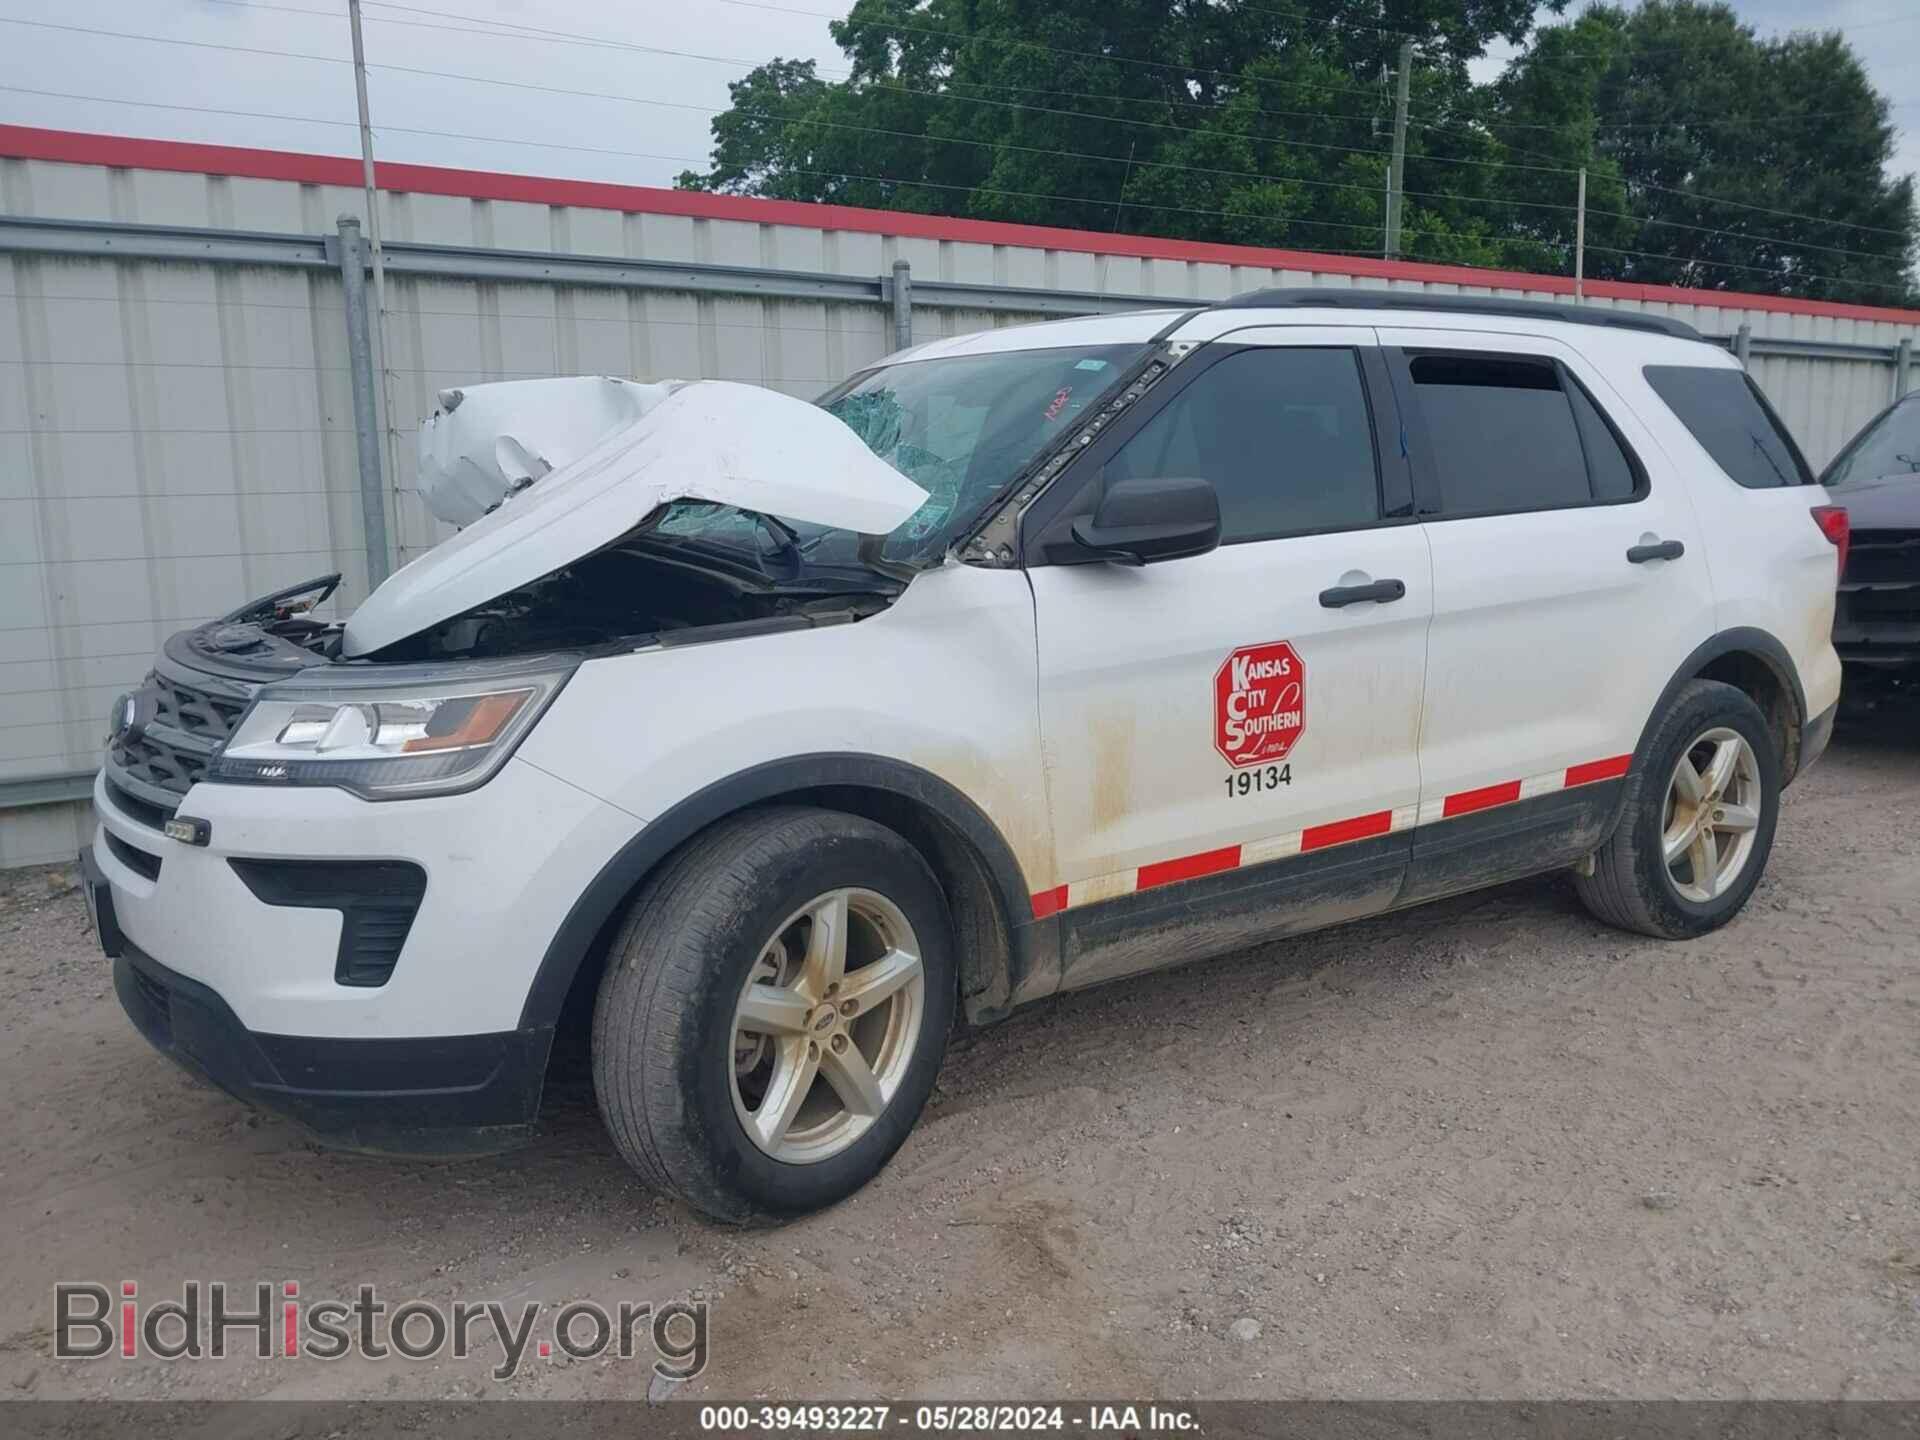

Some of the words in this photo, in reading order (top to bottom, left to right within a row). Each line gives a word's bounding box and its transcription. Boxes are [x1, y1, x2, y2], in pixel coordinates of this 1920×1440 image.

[1231, 655, 1291, 691] KANSAS
[1226, 689, 1267, 721] CITY
[1225, 711, 1301, 750] SOUTHERN
[1225, 764, 1292, 798] 19134
